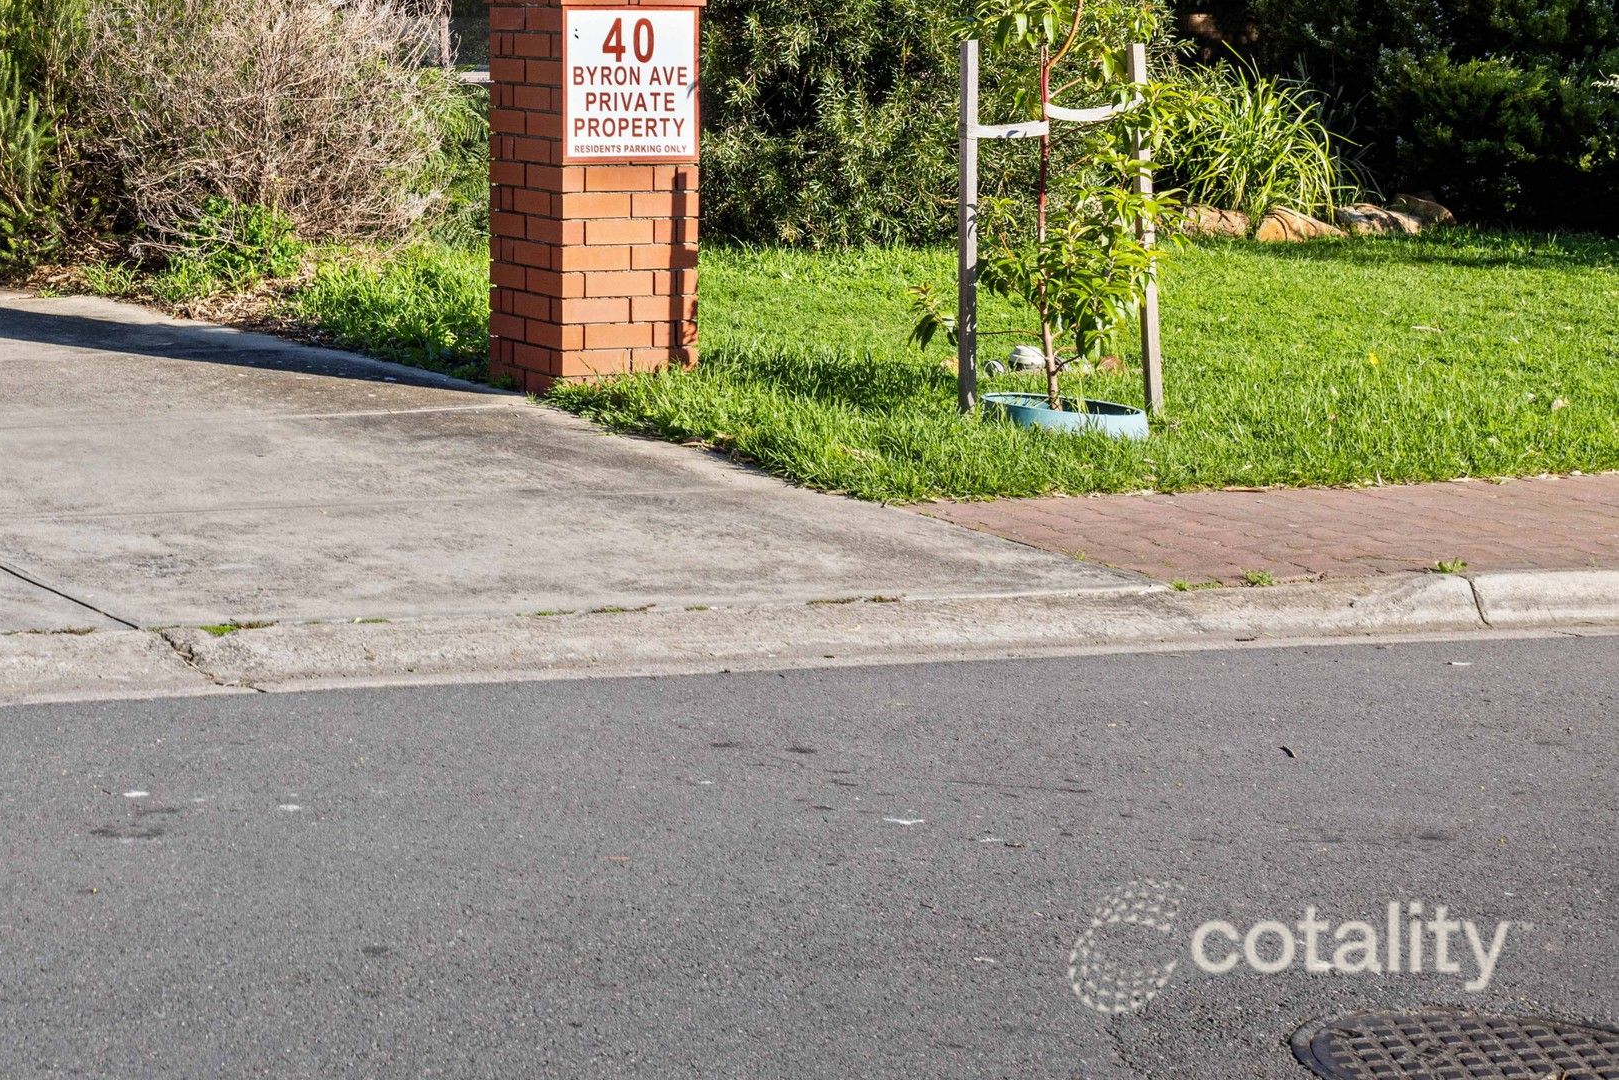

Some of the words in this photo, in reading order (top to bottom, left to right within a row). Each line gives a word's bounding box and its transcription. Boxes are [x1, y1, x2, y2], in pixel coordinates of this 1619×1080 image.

[602, 18, 655, 63] 40
[573, 66, 641, 86] BYRON
[649, 66, 688, 86] AVE
[586, 92, 675, 112] PRIVATE
[574, 118, 685, 137] PROPERTY
[574, 145, 621, 154] RESIDENTS
[624, 145, 662, 153] PARKING
[664, 144, 687, 153] ONLY
